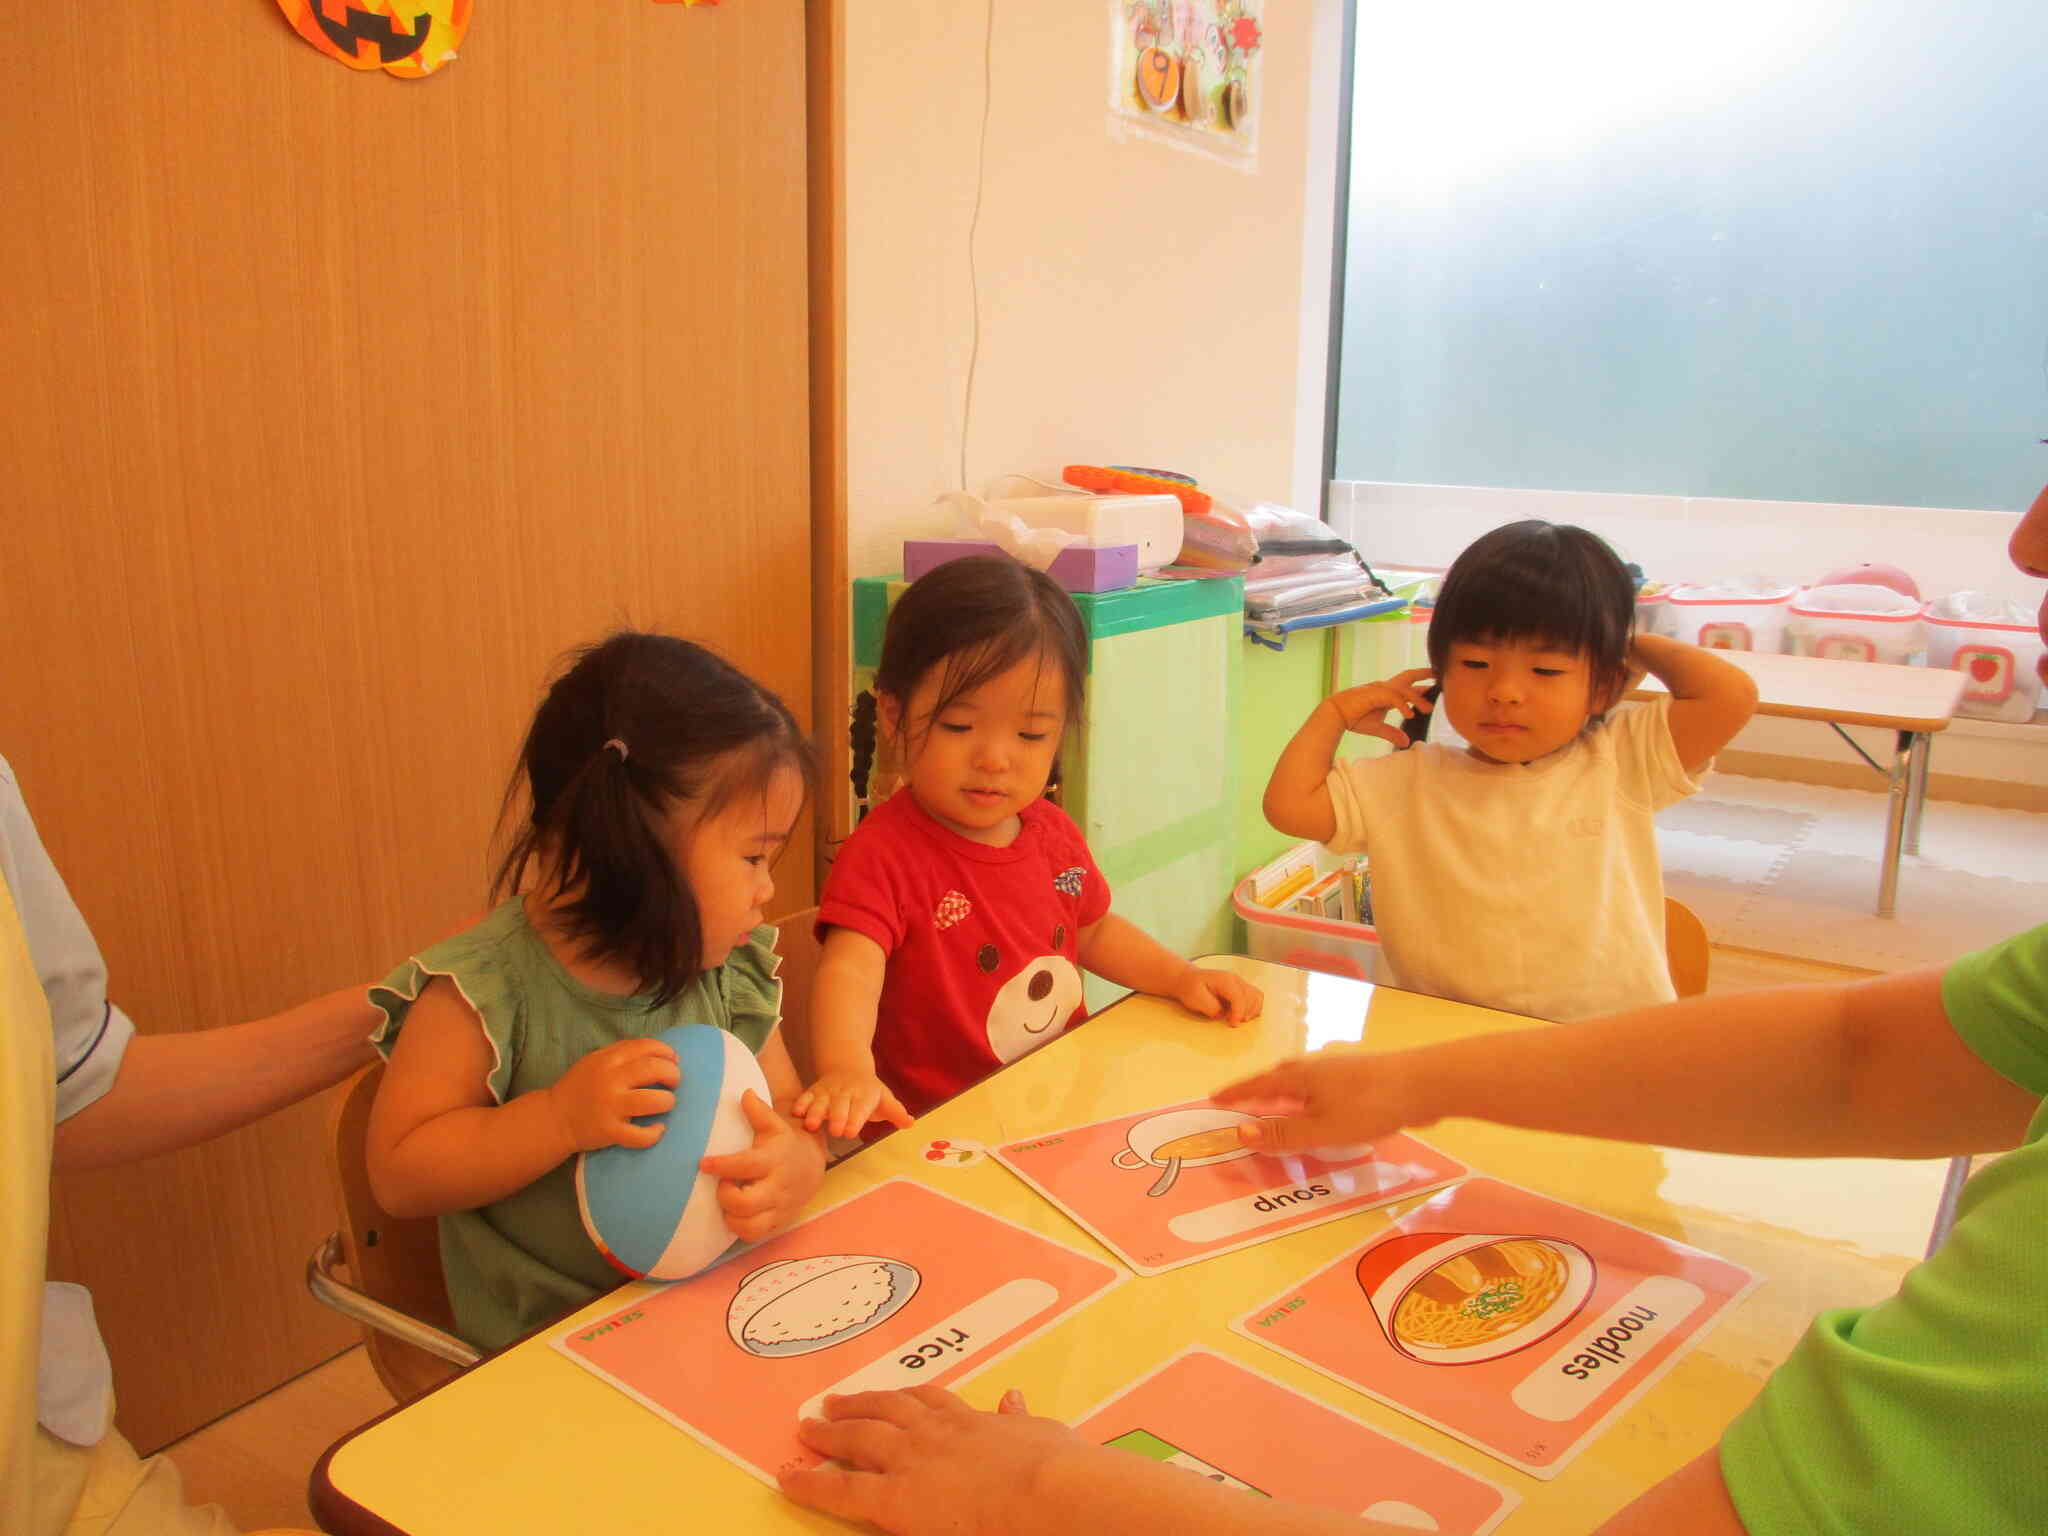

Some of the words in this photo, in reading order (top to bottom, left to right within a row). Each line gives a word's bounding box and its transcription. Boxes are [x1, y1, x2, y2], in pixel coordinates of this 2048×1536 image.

[1253, 1184, 1331, 1213] soup
[899, 1327, 970, 1369] rice
[1561, 1305, 1659, 1380] noodles
